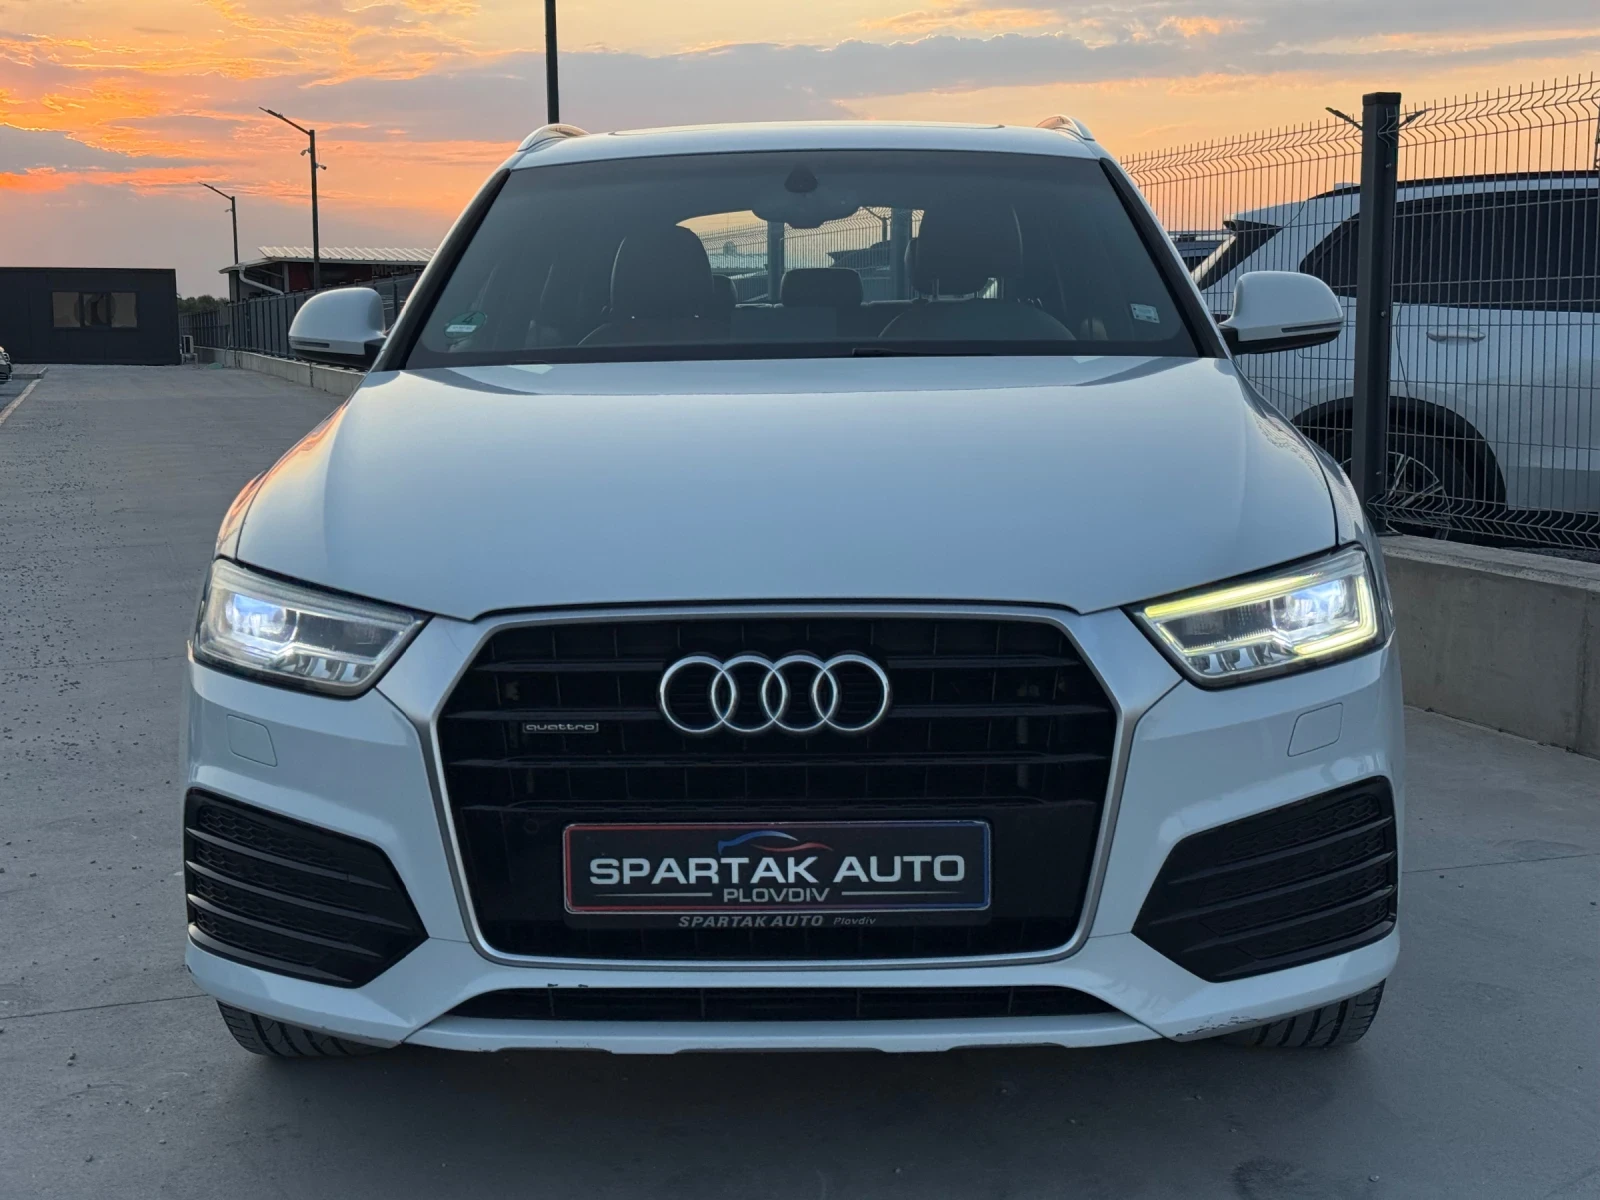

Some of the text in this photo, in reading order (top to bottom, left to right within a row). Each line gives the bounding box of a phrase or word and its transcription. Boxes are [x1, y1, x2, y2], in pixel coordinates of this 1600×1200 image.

[526, 723, 595, 731] quattro
[589, 854, 965, 885] SPARTAK AUTO
[723, 887, 830, 903] PLOVDIV
[678, 915, 876, 928] SPARTAK AUTO Plovdiv
